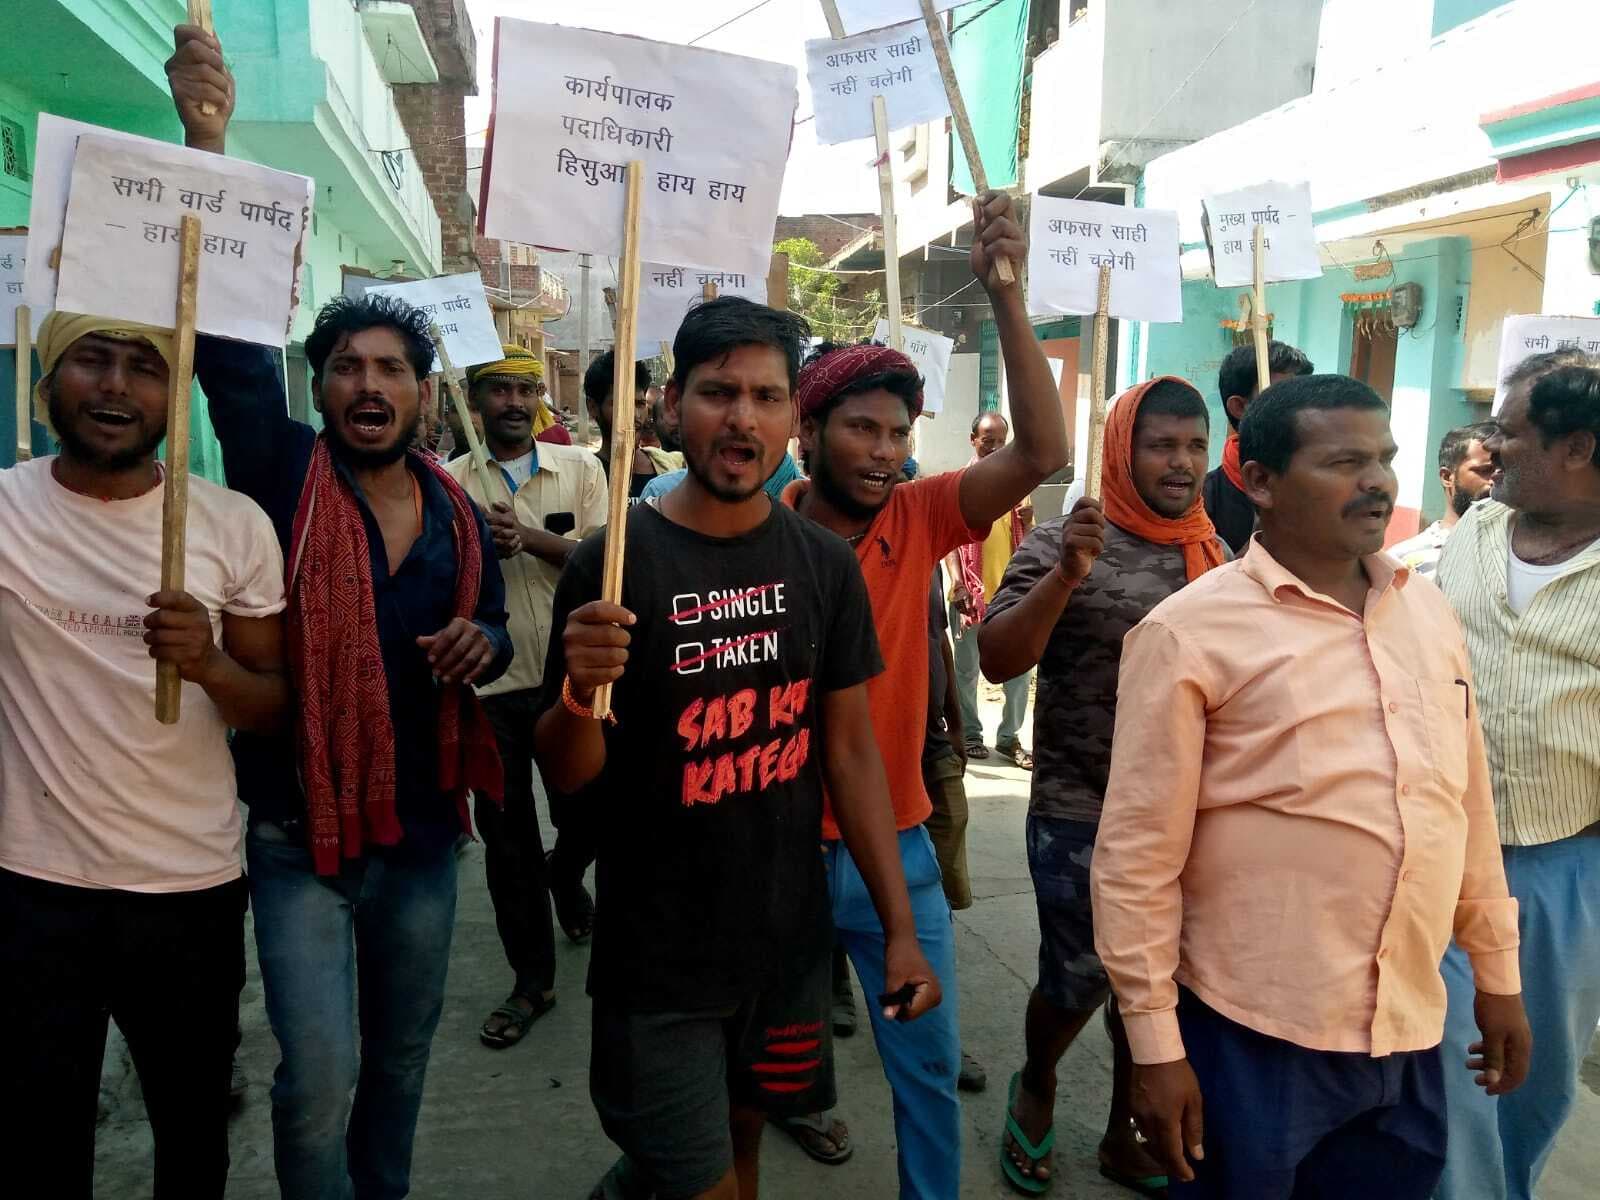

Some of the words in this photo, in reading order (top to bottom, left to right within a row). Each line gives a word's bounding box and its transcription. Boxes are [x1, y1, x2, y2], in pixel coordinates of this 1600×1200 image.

[826, 48, 877, 68] अफसर
[885, 35, 922, 58] साही
[564, 75, 675, 112] कार्यपालक
[828, 75, 858, 96] नहीं
[867, 65, 913, 89] चलेगी
[561, 115, 675, 152] पदाधिकारी
[557, 147, 627, 186] हिसुआ
[657, 171, 697, 195] हाय
[707, 180, 747, 203] हाय
[111, 175, 166, 203] सभी
[177, 188, 227, 214] वार्ड
[239, 201, 295, 232] पार्षद
[1251, 205, 1280, 224] पार्षद
[203, 233, 248, 259] हाय
[1048, 218, 1103, 239] अफसर
[1111, 223, 1149, 243] साही
[1223, 239, 1243, 254] हाय
[1048, 246, 1079, 266] नहीं
[1088, 249, 1137, 271] चलेगी
[652, 267, 689, 288] नहीं
[1525, 334, 1550, 350] सभी
[708, 583, 787, 621] SINGLE
[711, 631, 779, 669] TAKEN
[677, 689, 758, 752] SAB
